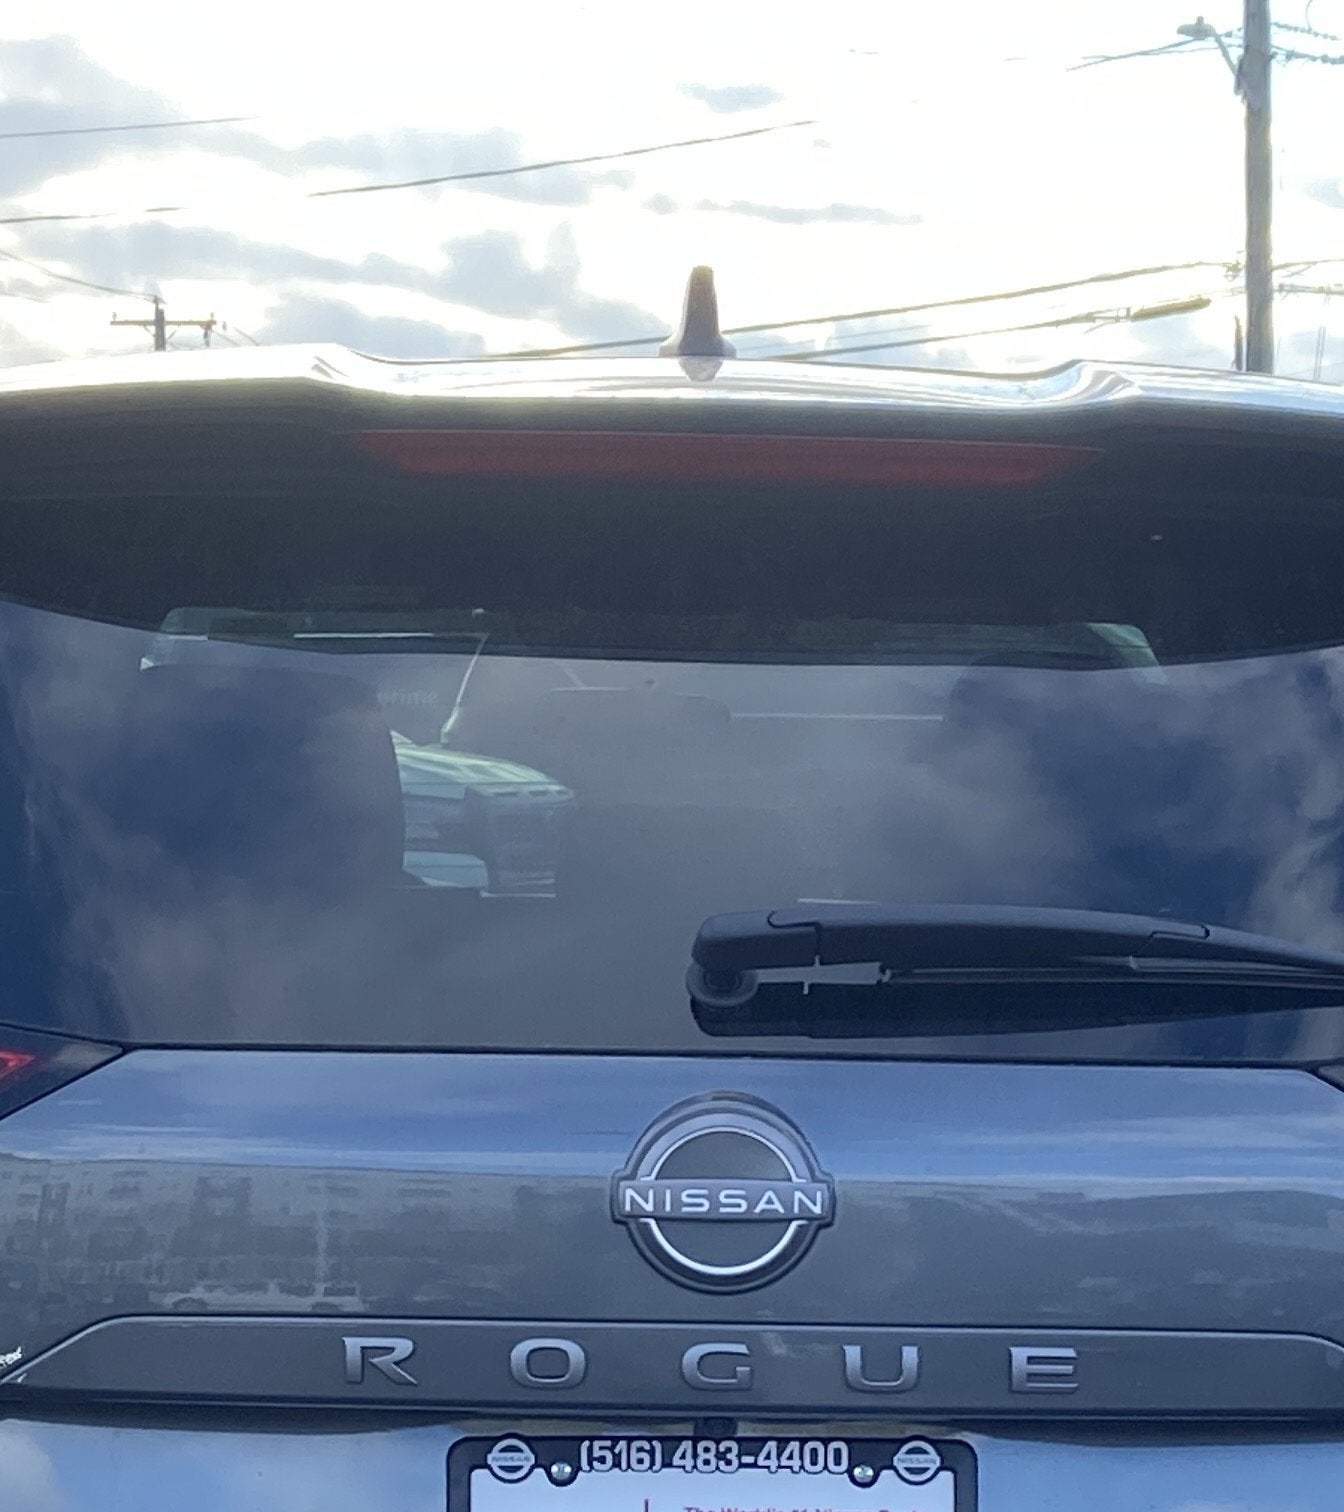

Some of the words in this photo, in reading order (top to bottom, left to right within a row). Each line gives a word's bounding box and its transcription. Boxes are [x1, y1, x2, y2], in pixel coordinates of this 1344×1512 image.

[624, 1187, 823, 1215] NISSAN
[340, 1335, 1080, 1393] ROGUE
[579, 1440, 663, 1473] (516)
[672, 1440, 850, 1475] 483-4400
